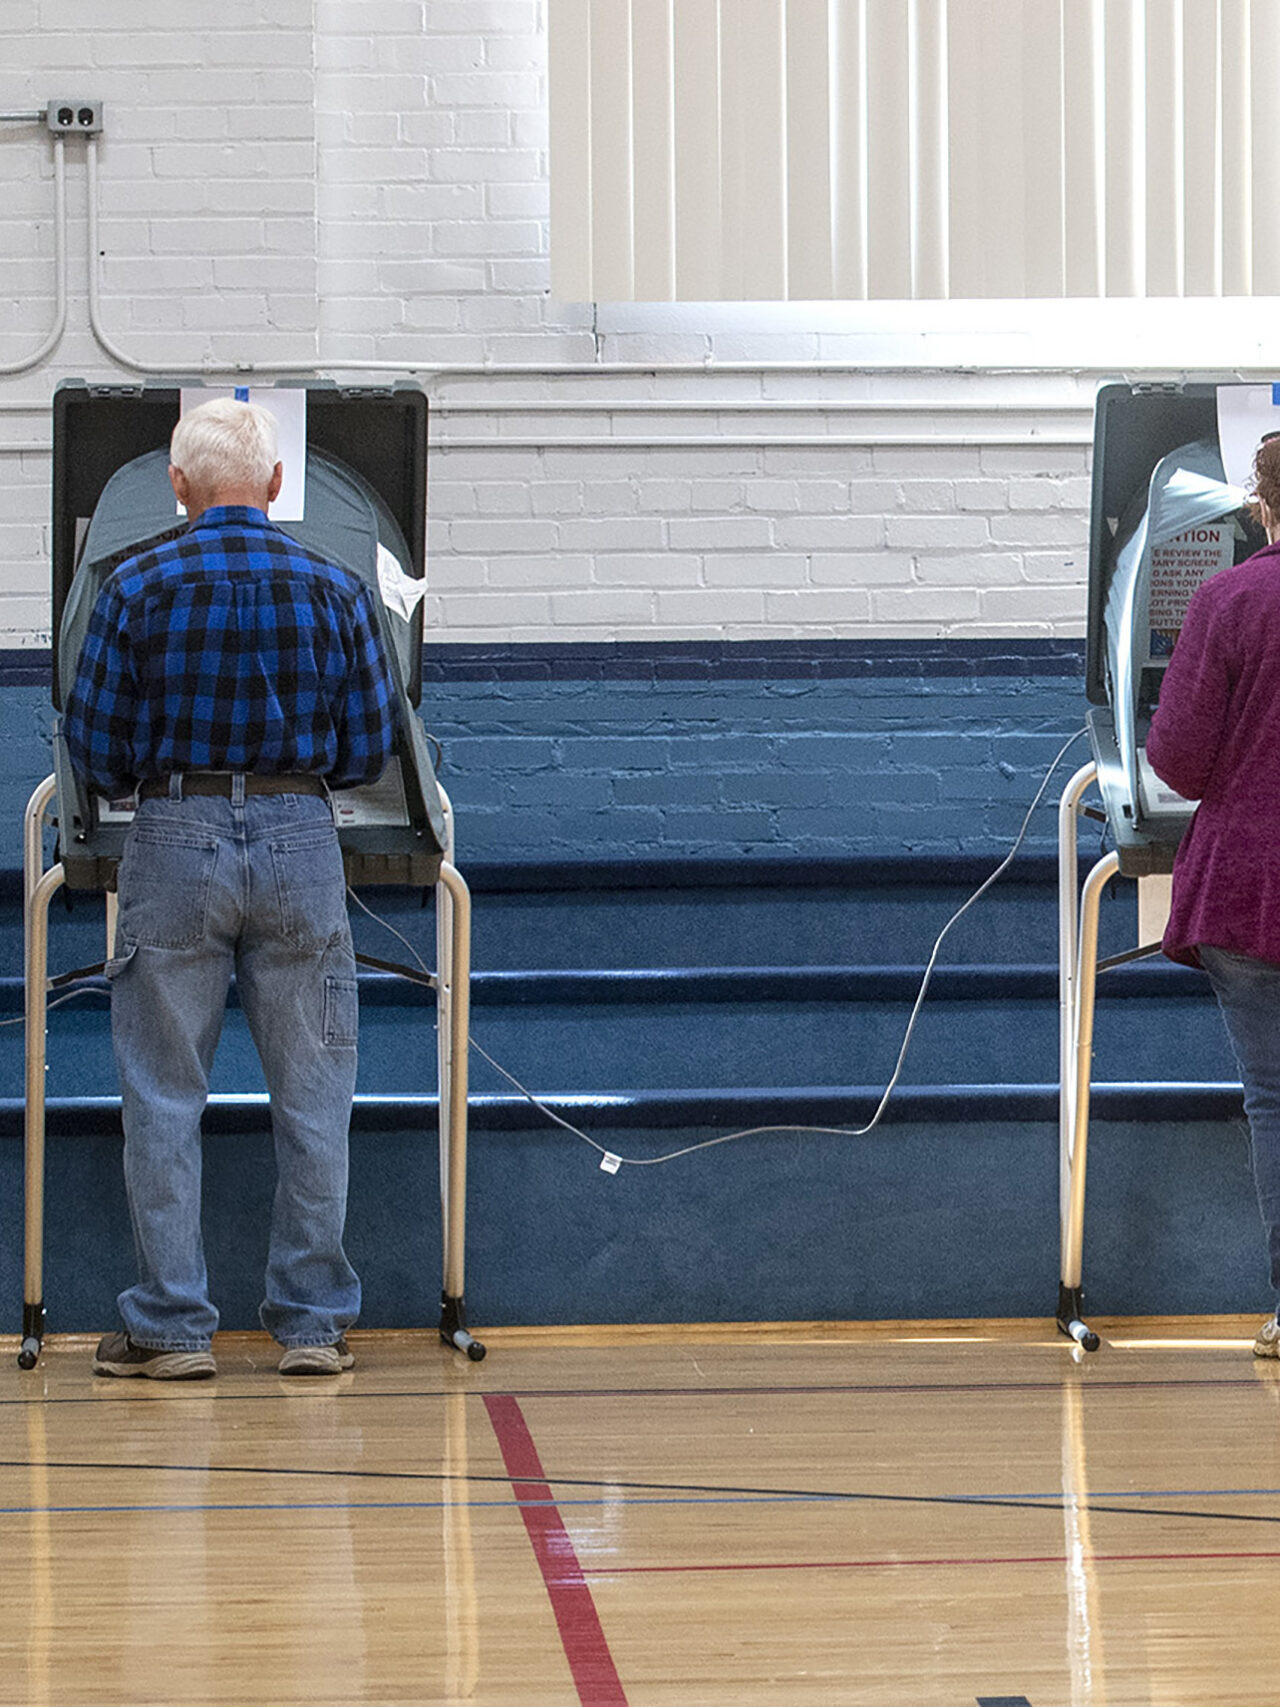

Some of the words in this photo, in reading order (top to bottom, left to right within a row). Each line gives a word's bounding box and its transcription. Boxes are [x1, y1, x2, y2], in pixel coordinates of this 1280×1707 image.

[1203, 549, 1222, 558] THE
[1184, 569, 1205, 577] ANY
[1175, 579, 1197, 588] YOU
